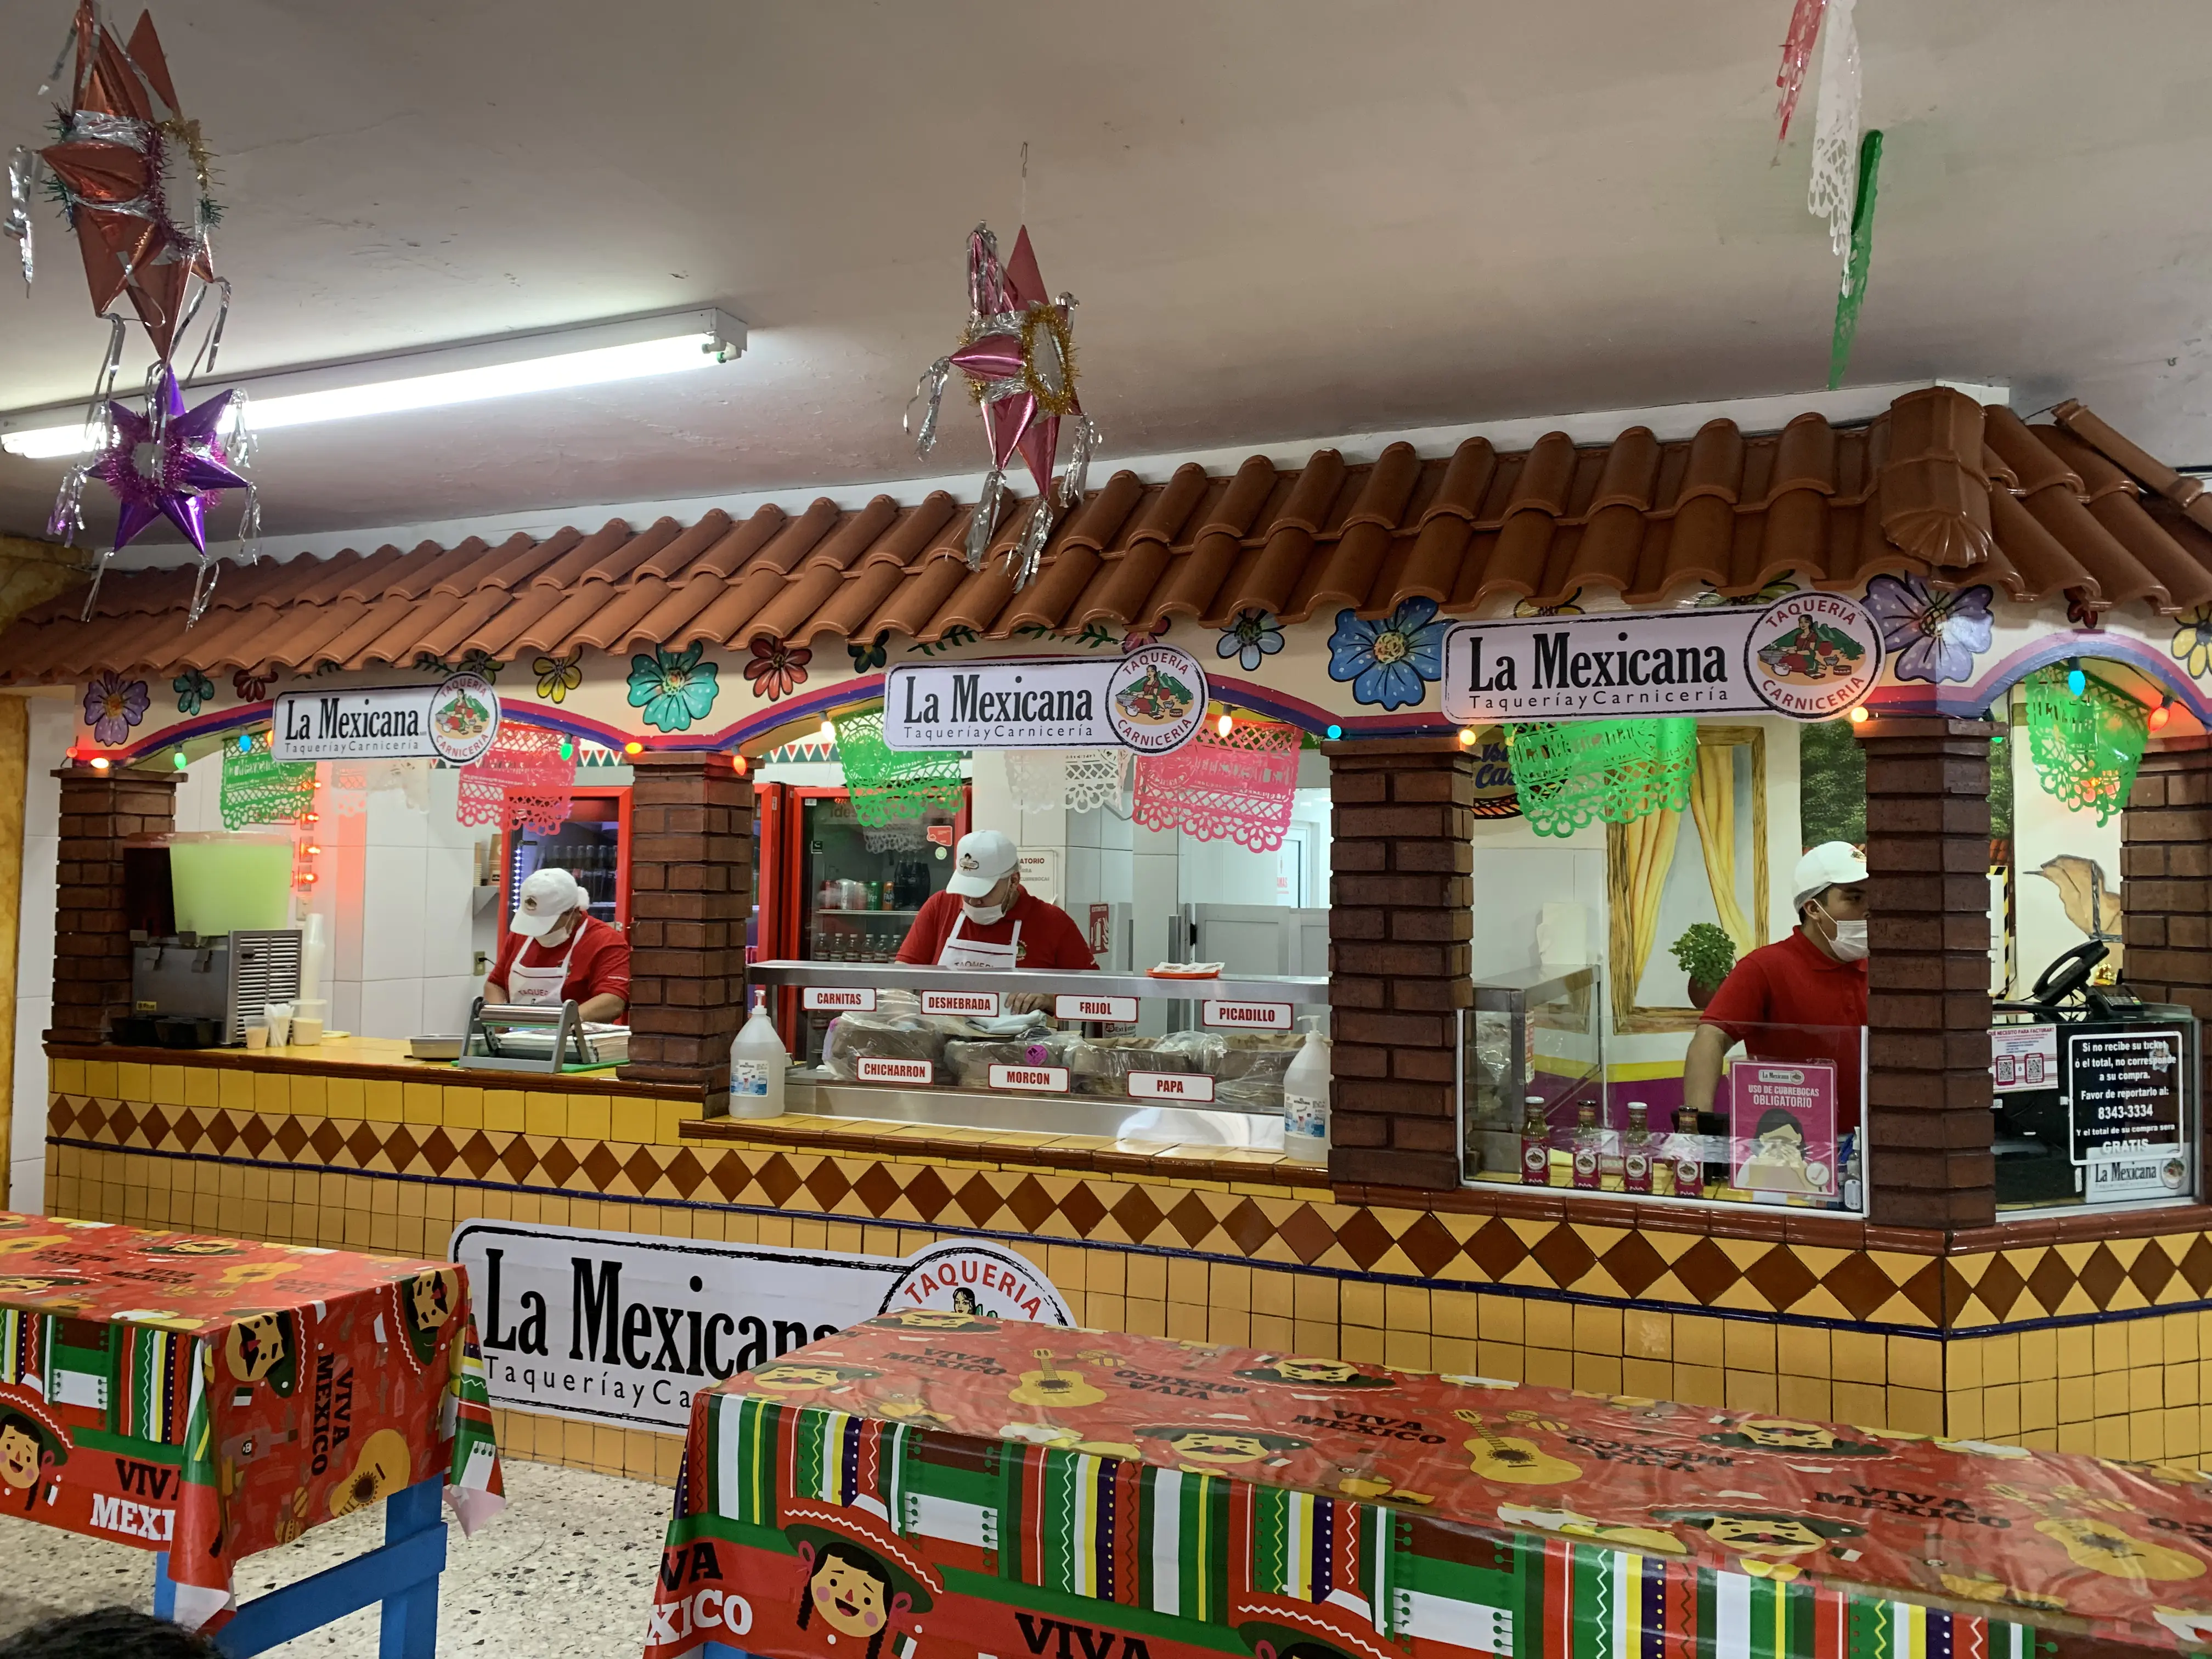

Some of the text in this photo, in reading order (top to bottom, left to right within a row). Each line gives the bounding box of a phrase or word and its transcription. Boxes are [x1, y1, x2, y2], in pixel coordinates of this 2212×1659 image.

[1765, 600, 1857, 628] TAQUERIA
[1122, 653, 1189, 676] TAQUERIA
[1469, 631, 1728, 692] La Mexicana
[441, 677, 487, 698] TAQUERIA
[904, 674, 1093, 724] La Mexicana
[1762, 675, 1864, 711] CARNICERIA
[285, 697, 419, 740] La Mexicana
[1116, 716, 1192, 746] CARNICERIA
[436, 733, 489, 757] CARNICERIA
[817, 992, 862, 1006] CARNITAS
[928, 996, 991, 1012] DESHEBRADA
[1079, 1001, 1113, 1015] FRIJOL
[1219, 1007, 1276, 1023] PICADILLO
[2104, 1041, 2130, 1052] recibe
[2132, 1042, 2142, 1050] su
[864, 1063, 926, 1079] CHICHARRON
[2082, 1058, 2090, 1068] el
[2091, 1057, 2114, 1069] total,
[2115, 1058, 2125, 1066] no
[1006, 1070, 1050, 1086] MORCON
[1156, 1079, 1184, 1094] PAPA
[2099, 1071, 2151, 1081] a su compra.
[1748, 1084, 1820, 1097] USO DE CUBREBOCAS
[1753, 1094, 1813, 1108] OBLIGATORIO
[2081, 1086, 2169, 1100] Favor de reportarlo al:
[2097, 1103, 2154, 1120] 8343-3334
[2092, 1127, 2109, 1136] total
[2111, 1126, 2120, 1135] de
[2131, 1124, 2158, 1133] compra
[2102, 1138, 2149, 1154] GRATIS
[2095, 1160, 2157, 1183] La Mexicana
[904, 1259, 1042, 1321] TAQUERIA
[483, 1249, 840, 1381] La Mexican
[311, 1352, 335, 1476] MEXICO
[331, 1367, 354, 1449] VIVA
[1291, 1414, 1447, 1444] MEXICO
[1333, 1410, 1424, 1431] VIVA
[115, 1458, 182, 1501] VIV
[1849, 1485, 1975, 1512] VIVA
[89, 1492, 176, 1542] MEXI
[1815, 1492, 2012, 1529] MEXICO
[659, 1542, 724, 1592] VA
[645, 1589, 753, 1646] XICO
